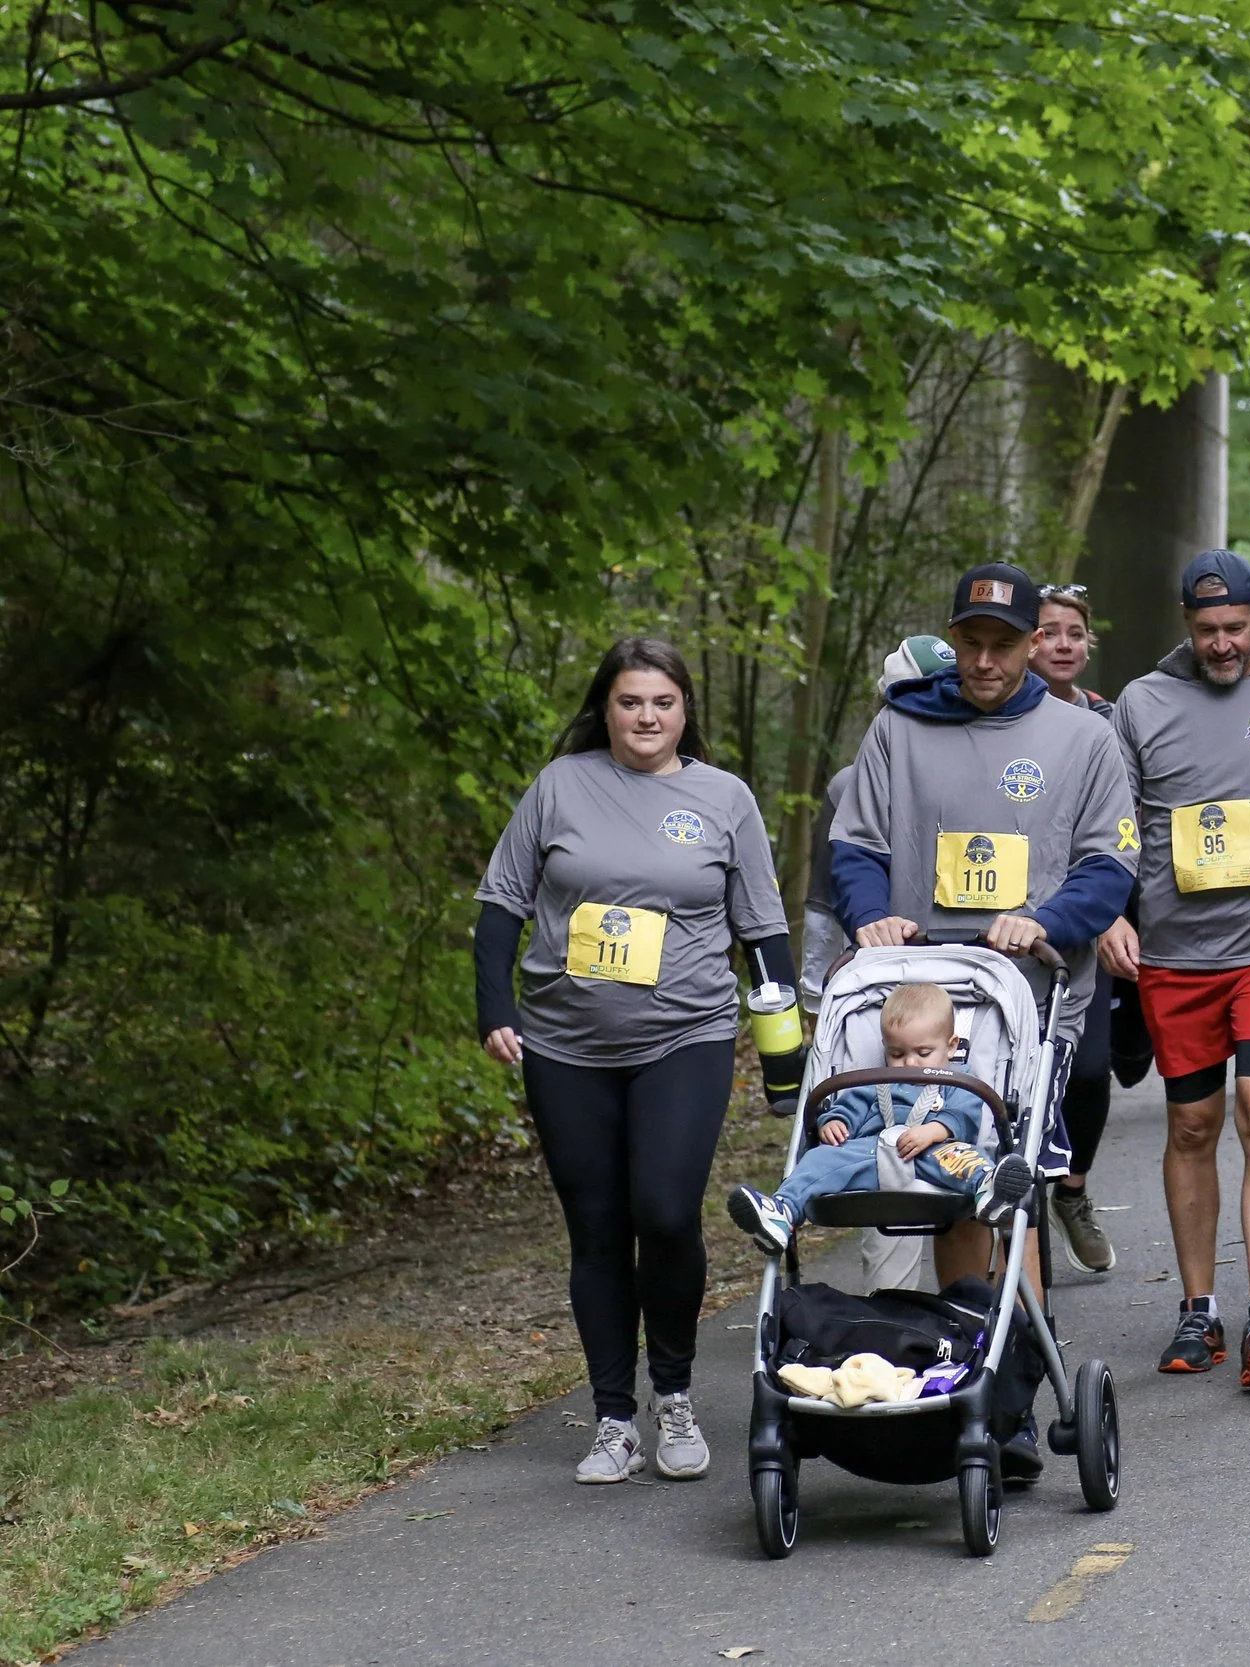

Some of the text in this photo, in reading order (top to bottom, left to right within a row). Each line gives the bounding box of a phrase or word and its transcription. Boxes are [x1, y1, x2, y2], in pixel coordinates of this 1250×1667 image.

[1017, 775, 1042, 785] STRONG
[1204, 834, 1225, 855] 95
[964, 869, 997, 892] 110
[598, 940, 630, 966] 111
[598, 965, 630, 974] DUFFY
